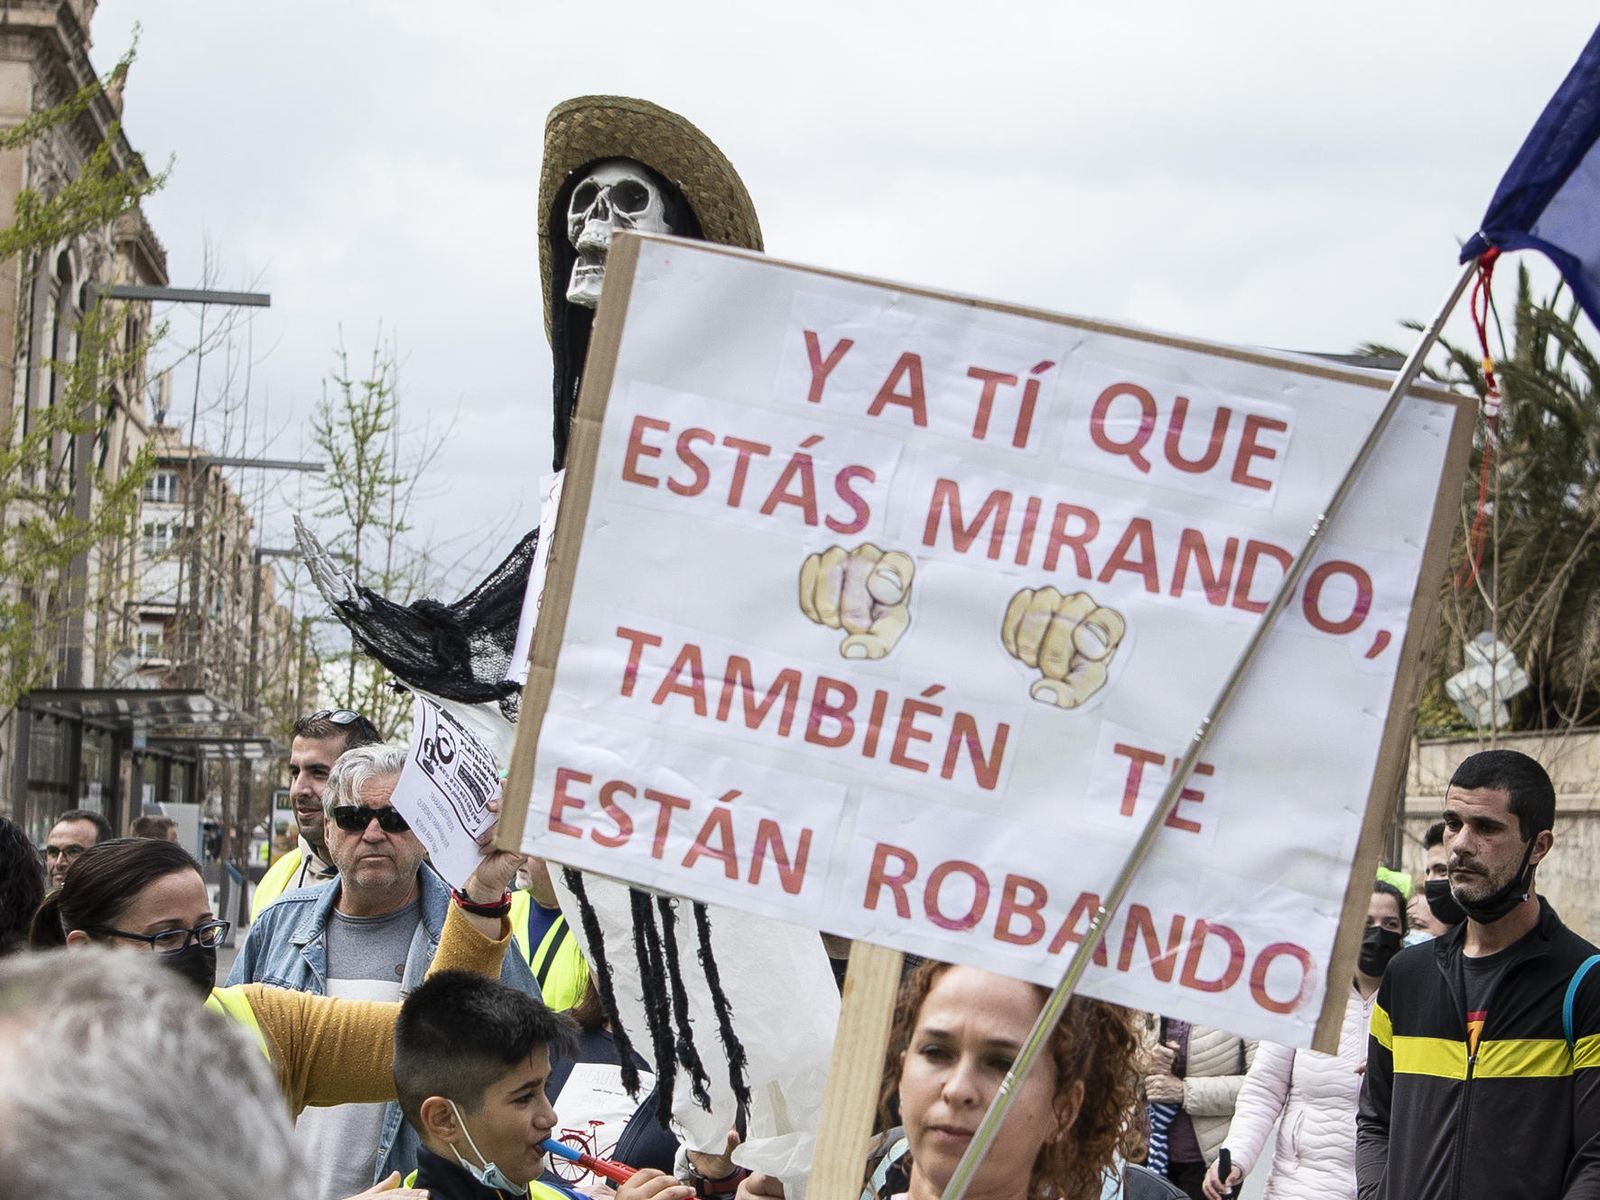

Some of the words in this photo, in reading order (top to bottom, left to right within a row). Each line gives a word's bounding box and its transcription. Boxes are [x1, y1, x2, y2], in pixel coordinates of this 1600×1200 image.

[804, 331, 853, 403] Y
[868, 352, 928, 427] A
[967, 360, 1054, 449] TÍ
[1089, 383, 1285, 492] QUE
[623, 415, 876, 536] ESTÁS
[923, 479, 1392, 660] MIRANDO,
[616, 626, 1010, 790] TAMBIÉN
[1114, 743, 1214, 834] TE
[549, 767, 813, 894] ESTÁN
[863, 842, 1316, 1014] ROBANDO
